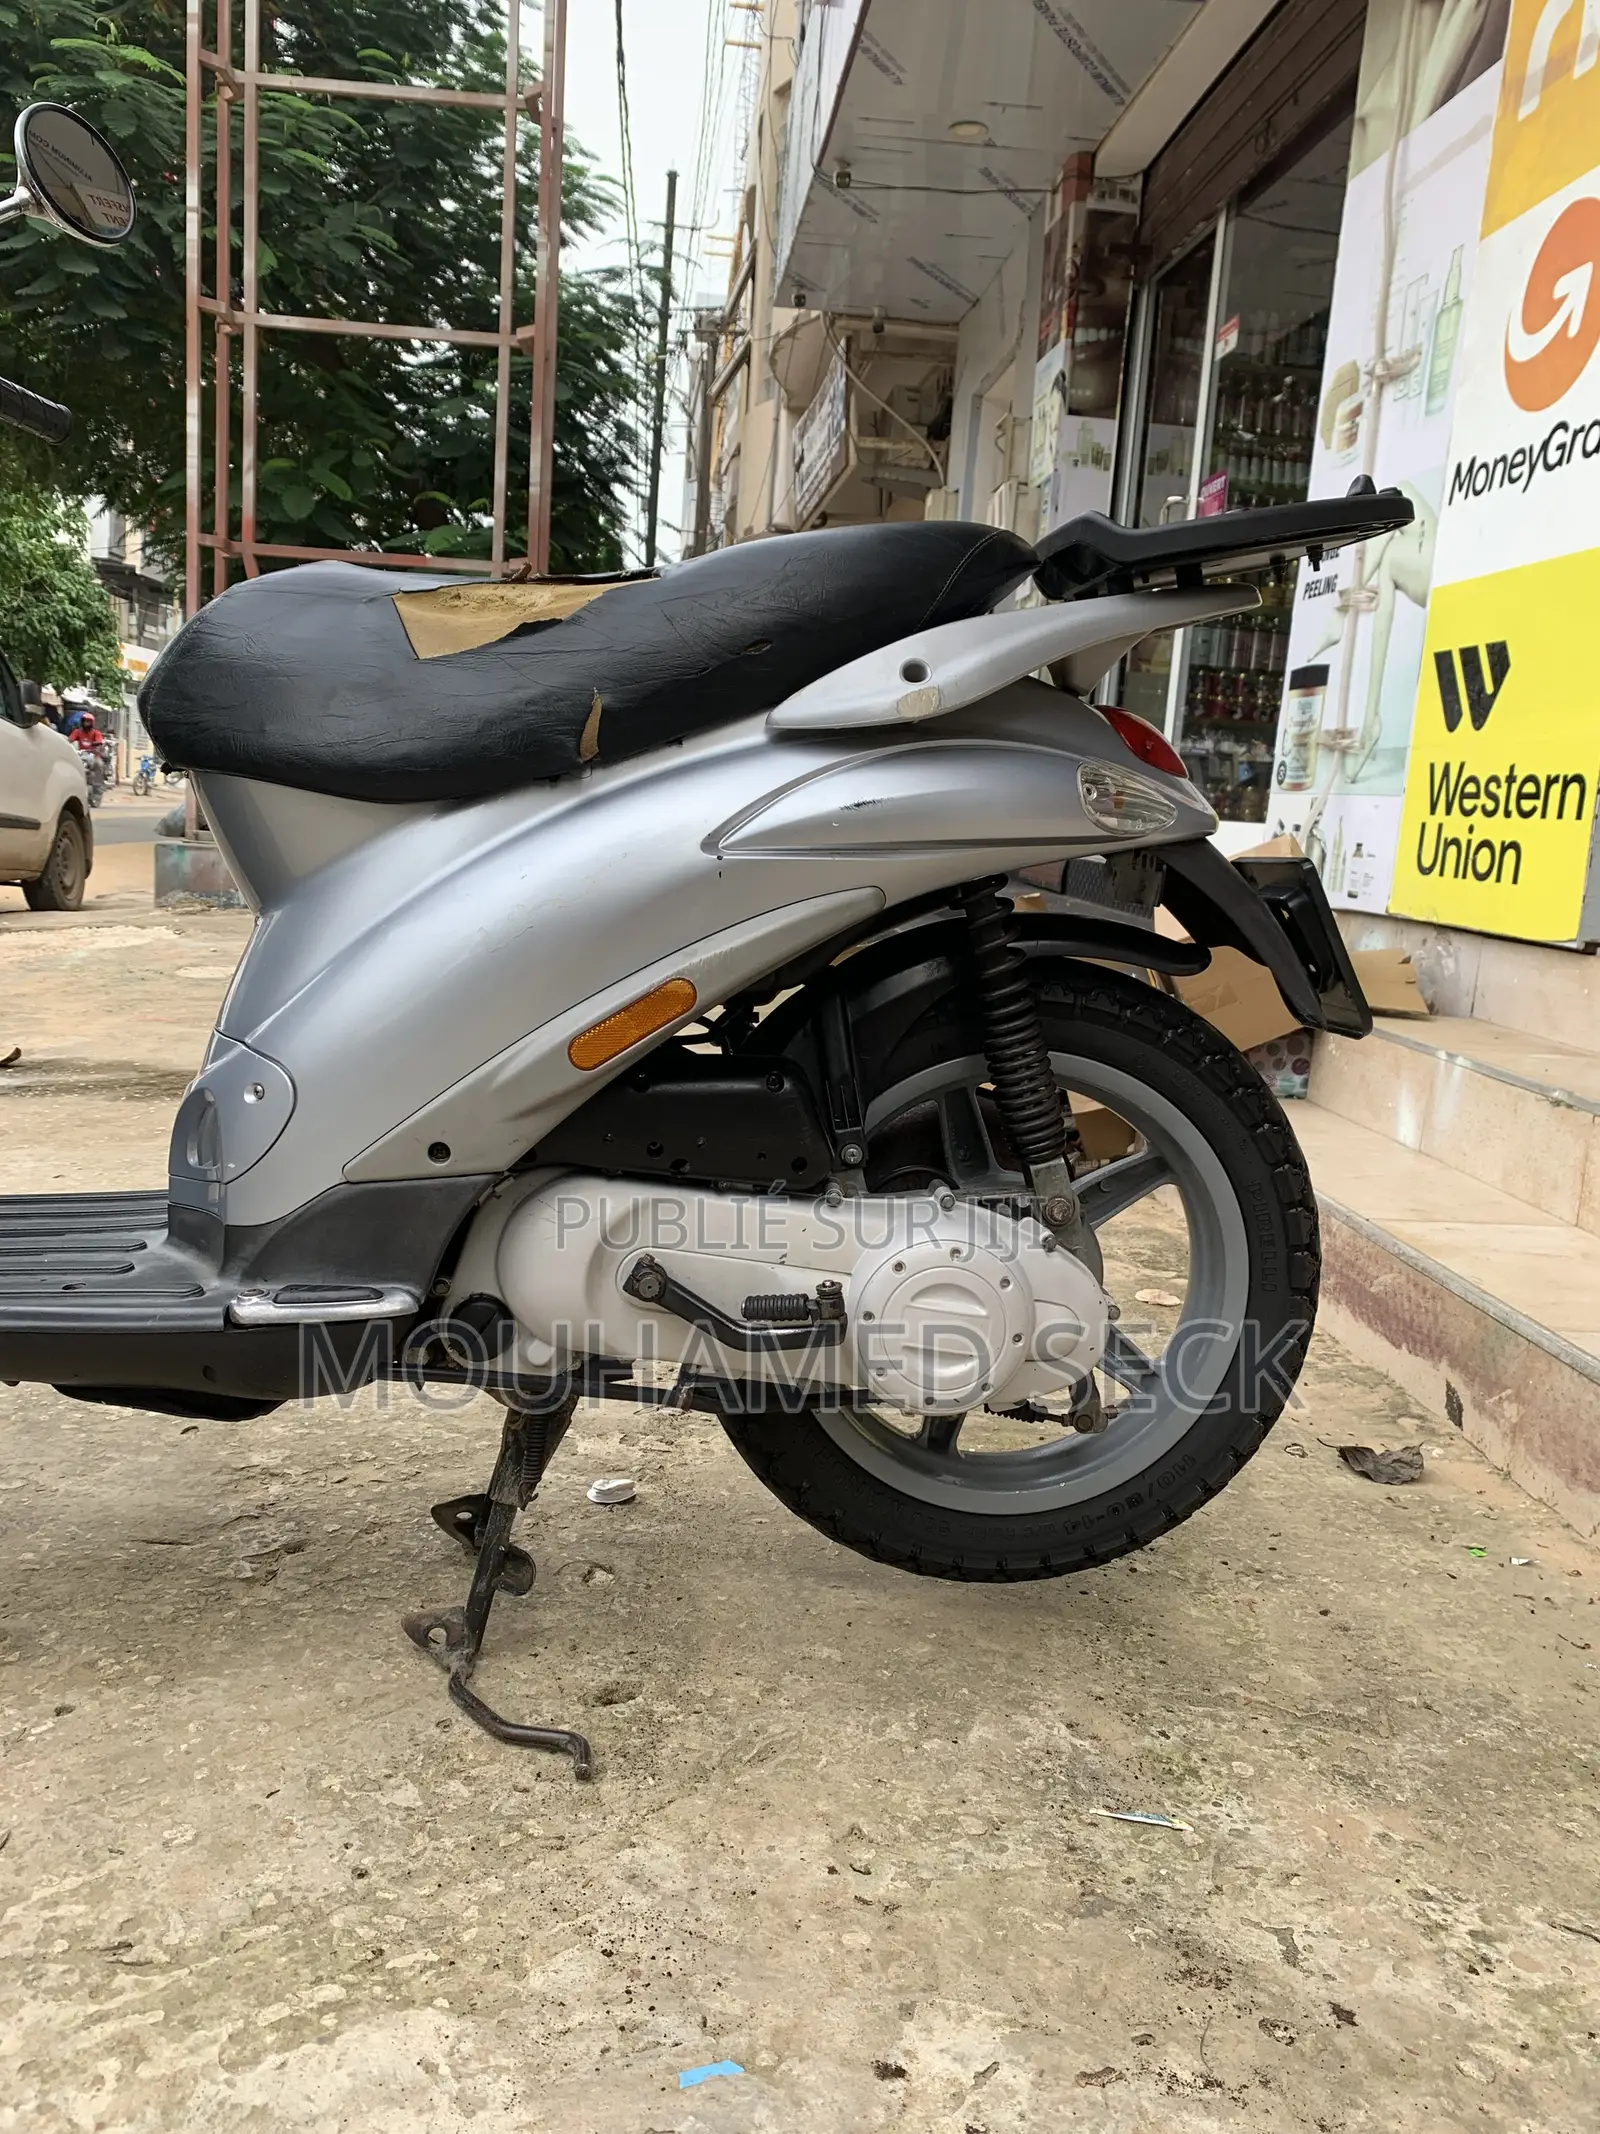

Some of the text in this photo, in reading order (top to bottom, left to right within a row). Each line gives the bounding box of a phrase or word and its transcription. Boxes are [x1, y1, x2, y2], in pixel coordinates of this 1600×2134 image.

[1302, 573, 1338, 601] PEELING
[1429, 761, 1587, 821] Western
[1417, 822, 1523, 885] Union
[1248, 1180, 1278, 1293] PIRELLI
